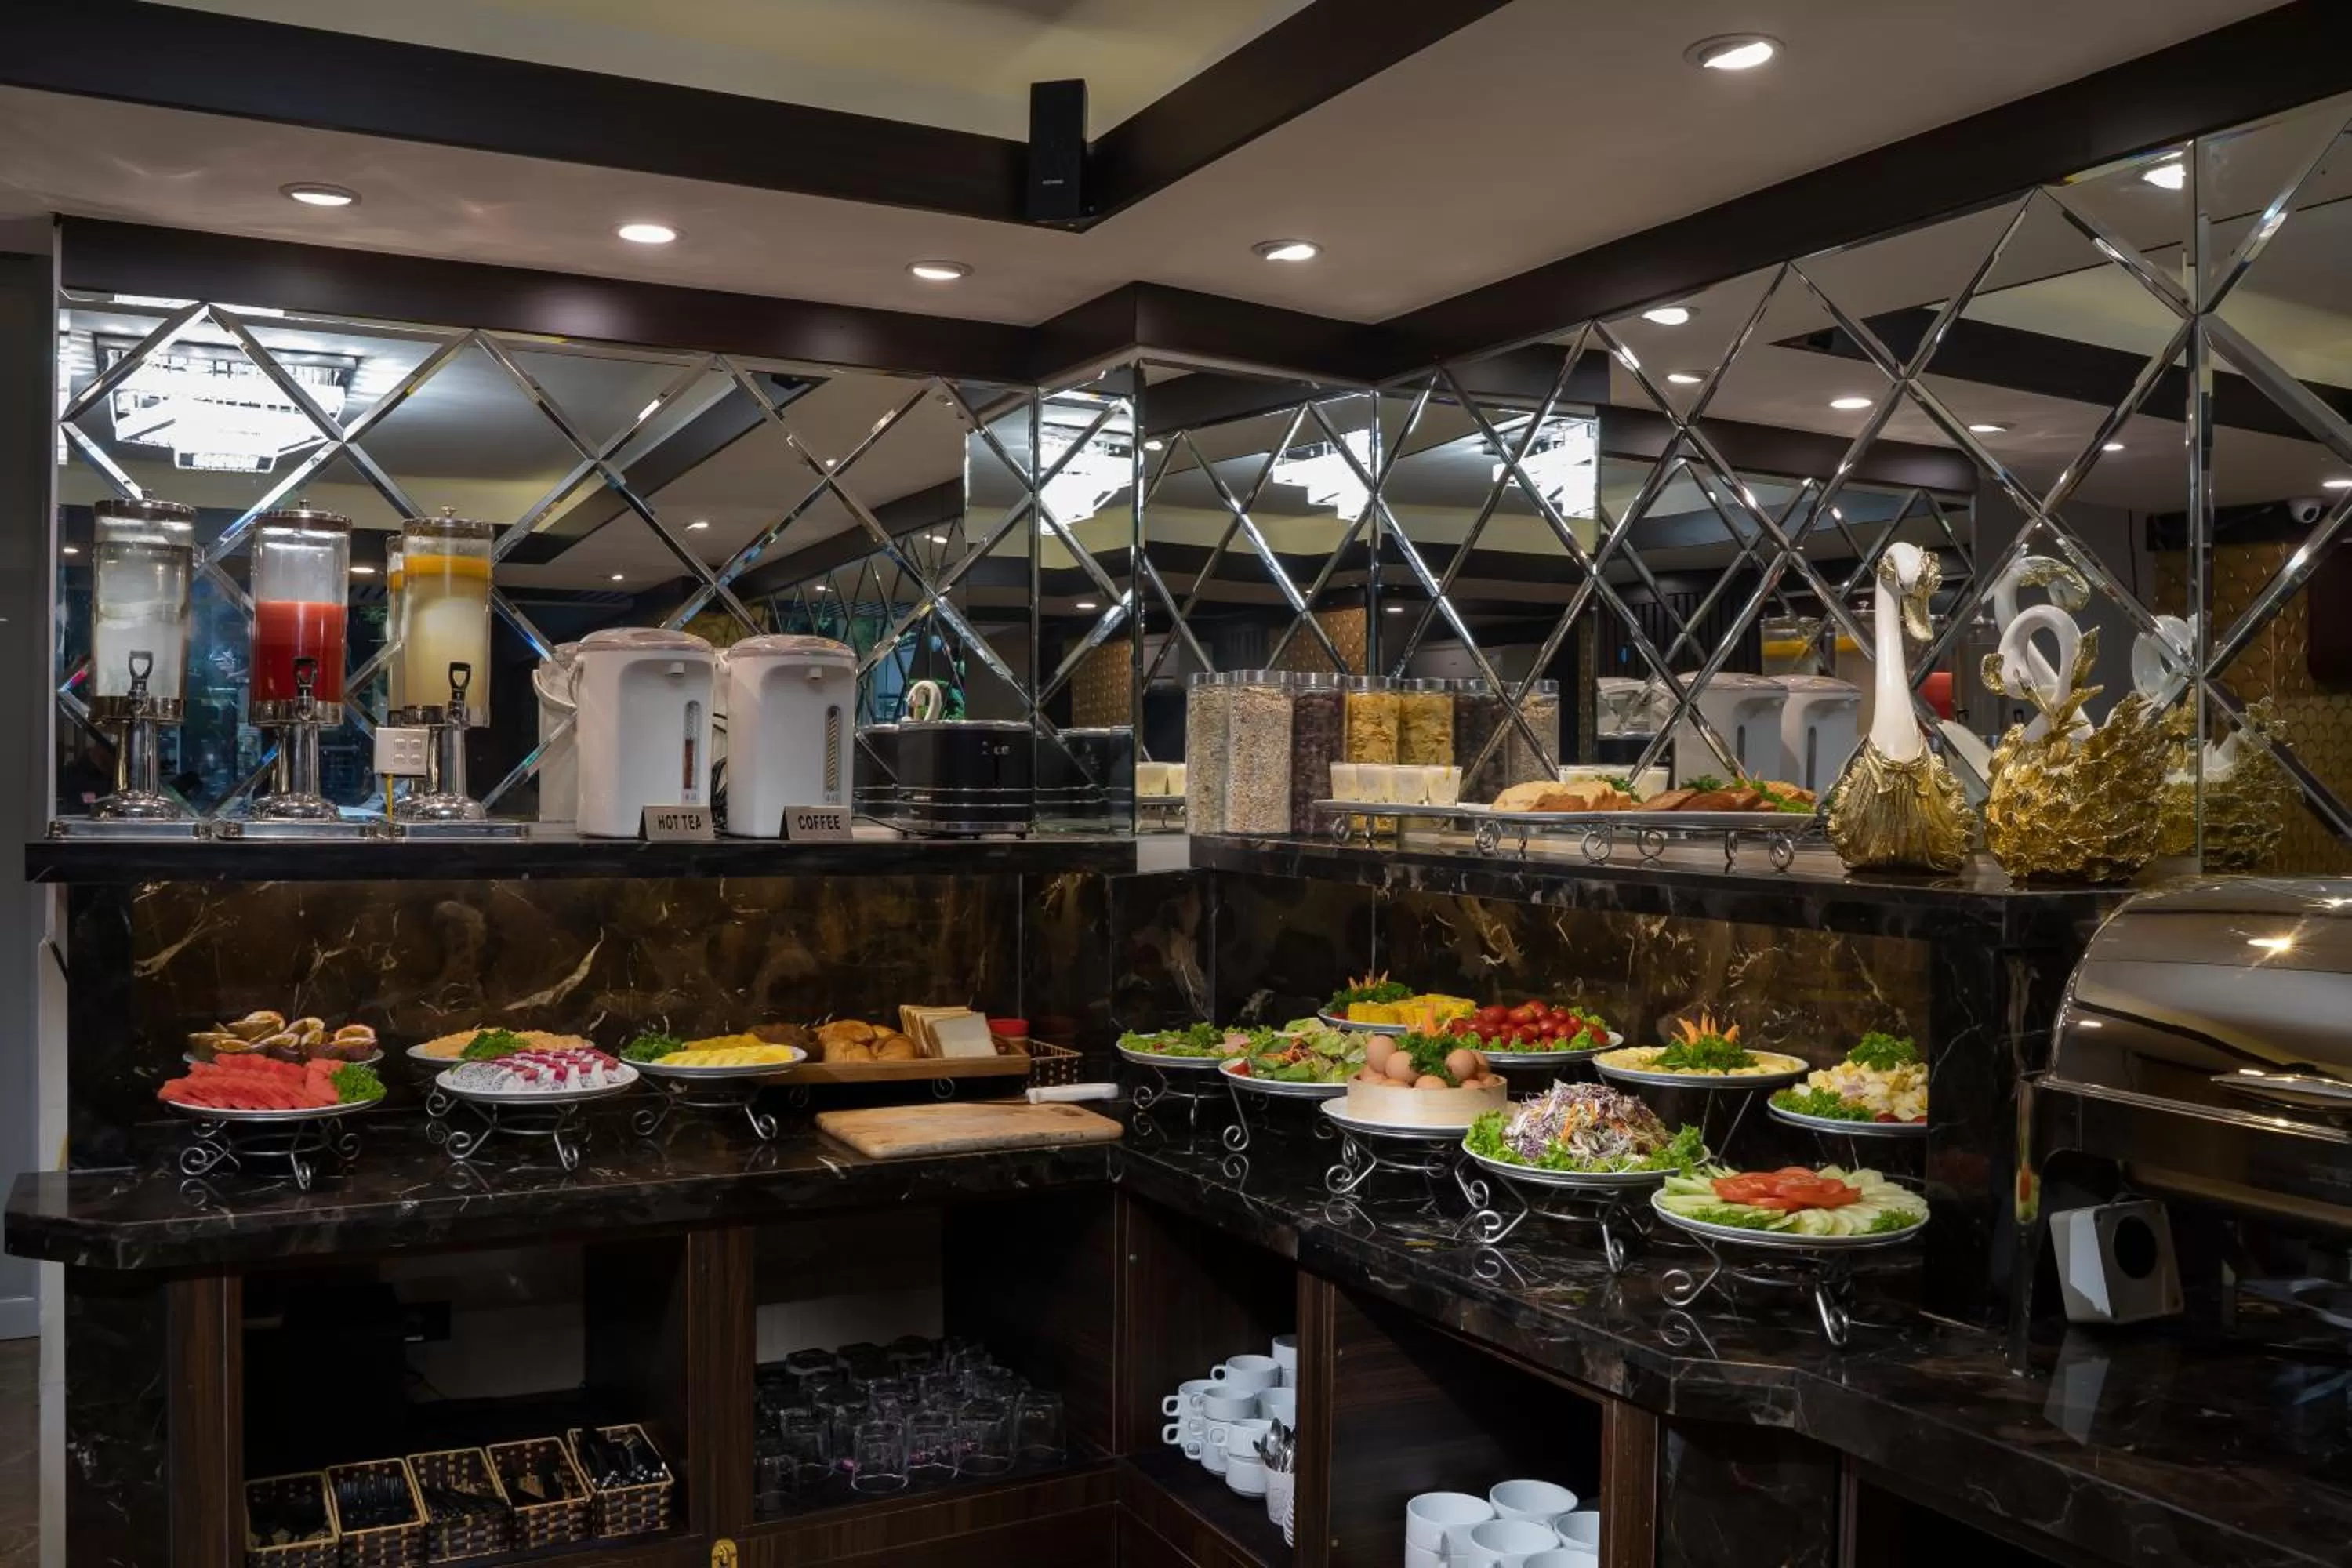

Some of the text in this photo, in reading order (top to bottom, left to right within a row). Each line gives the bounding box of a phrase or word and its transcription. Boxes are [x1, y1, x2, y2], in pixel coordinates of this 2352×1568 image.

[658, 815, 702, 830] HOT TEA
[797, 815, 841, 830] COFFEE
